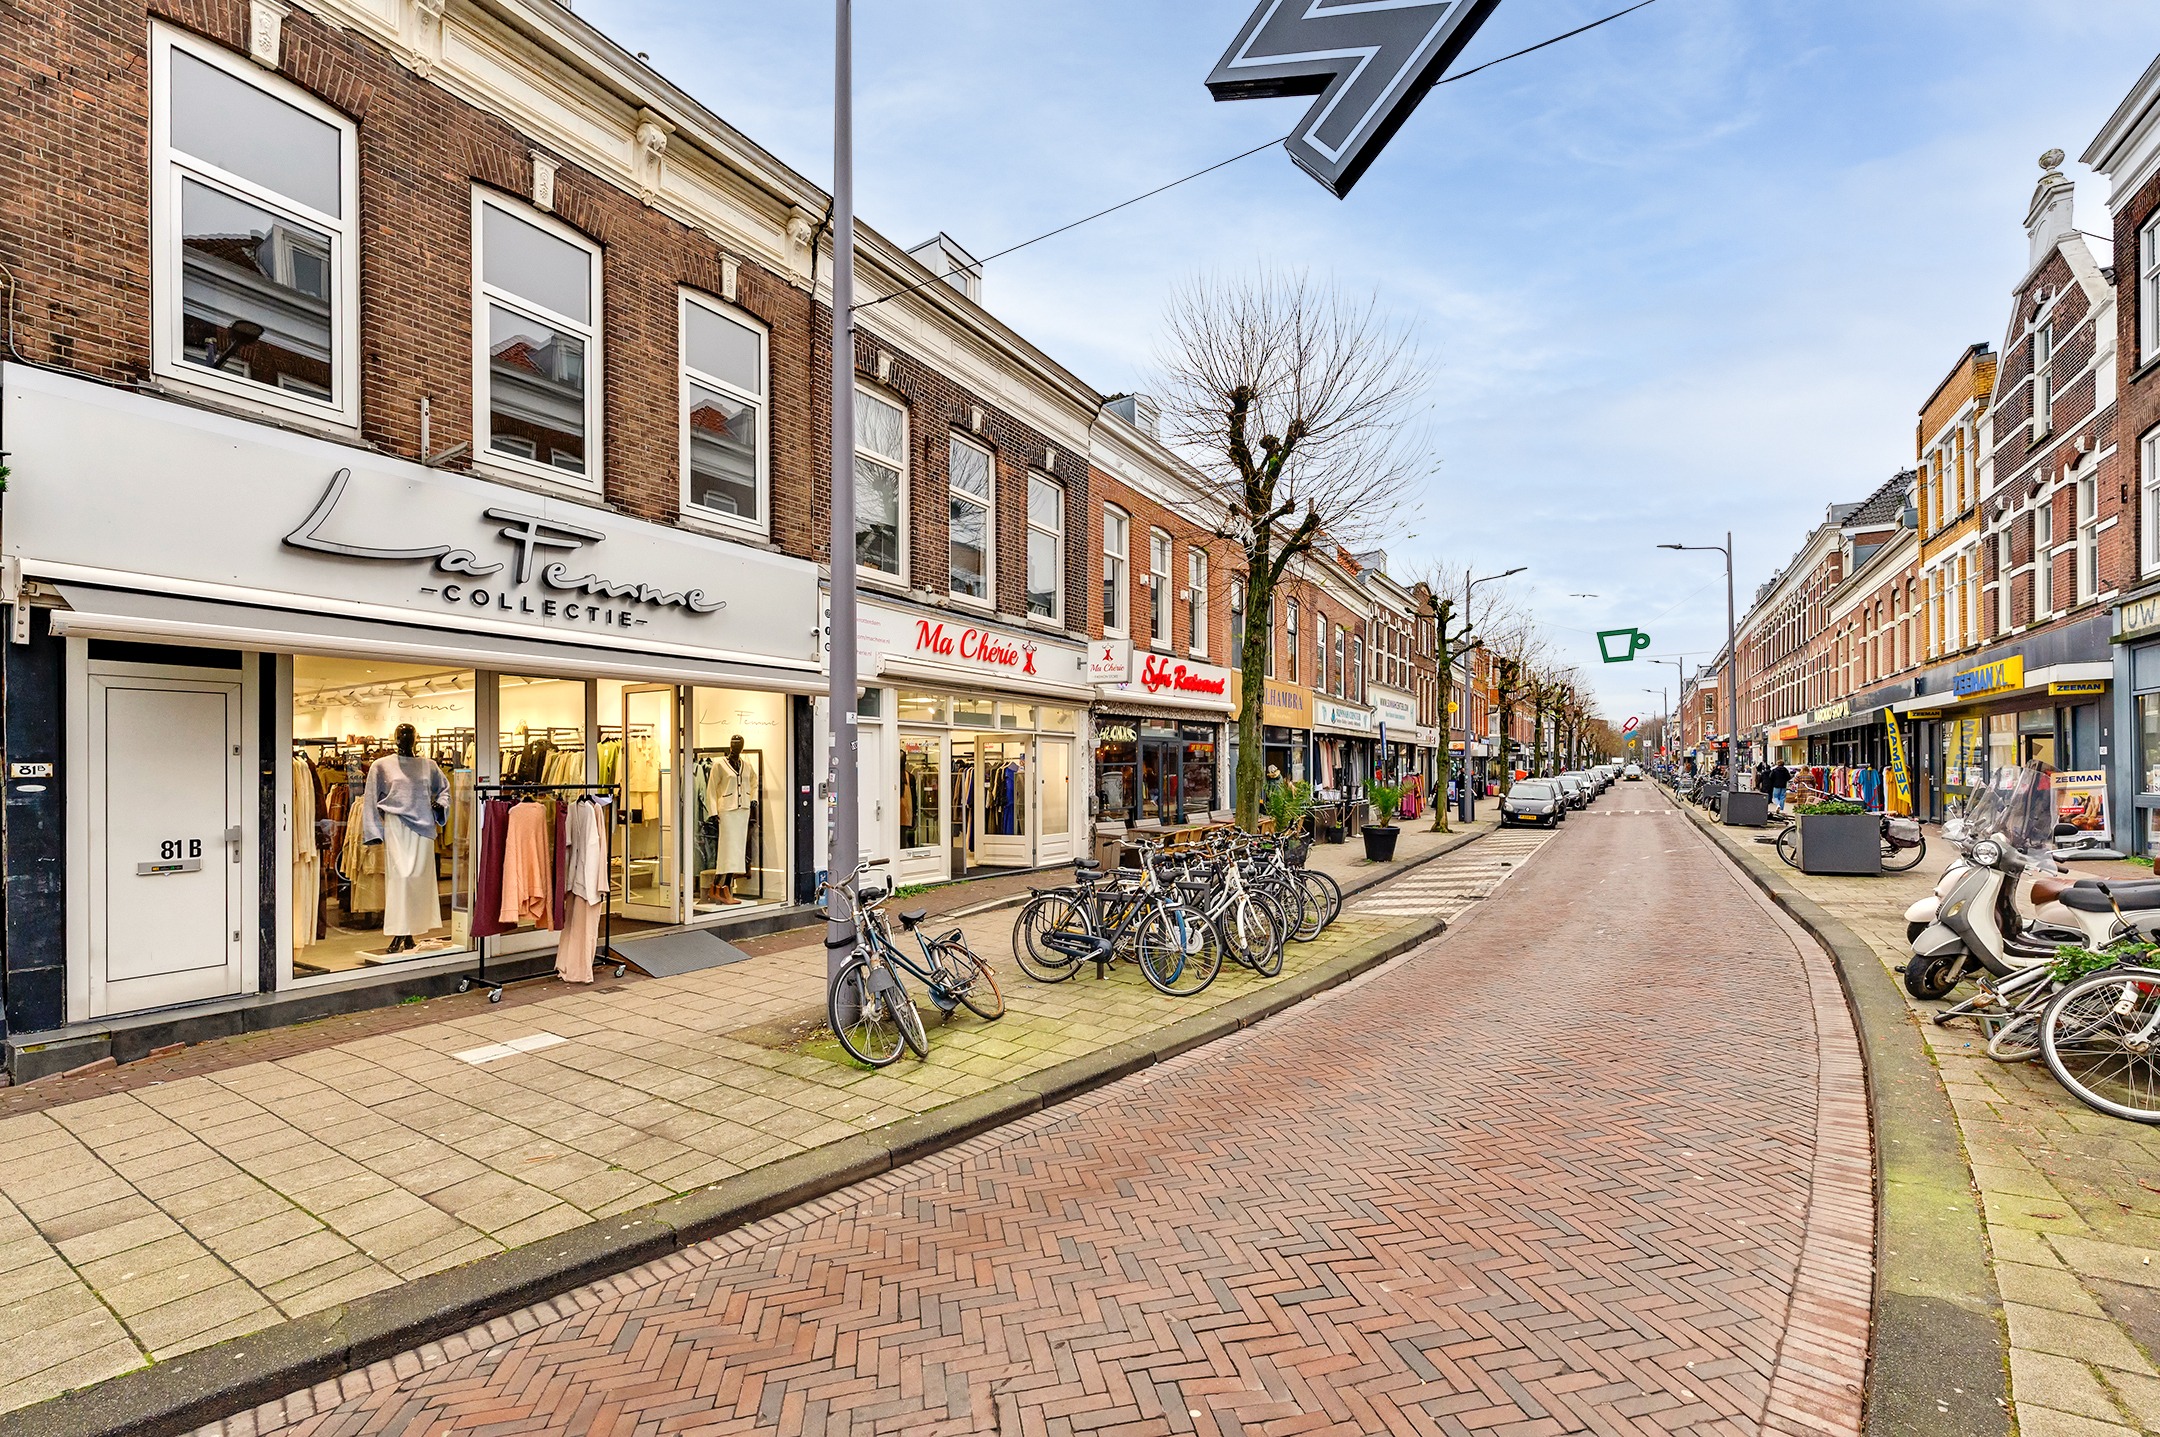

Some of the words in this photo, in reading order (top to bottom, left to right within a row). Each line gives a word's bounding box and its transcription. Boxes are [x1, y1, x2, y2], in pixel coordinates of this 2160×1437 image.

[282, 467, 504, 577] La
[484, 507, 727, 613] Femme
[916, 620, 955, 656] Ma
[960, 628, 1019, 666] Chérie
[1953, 666, 1993, 697] ZEEMAN
[1996, 663, 2008, 687] XL
[2056, 683, 2102, 692] ZEEMAN
[1262, 687, 1303, 711] LHAMBRA
[2055, 774, 2102, 784] ZEEMAN
[160, 840, 182, 860] 81
[189, 839, 202, 858] B
